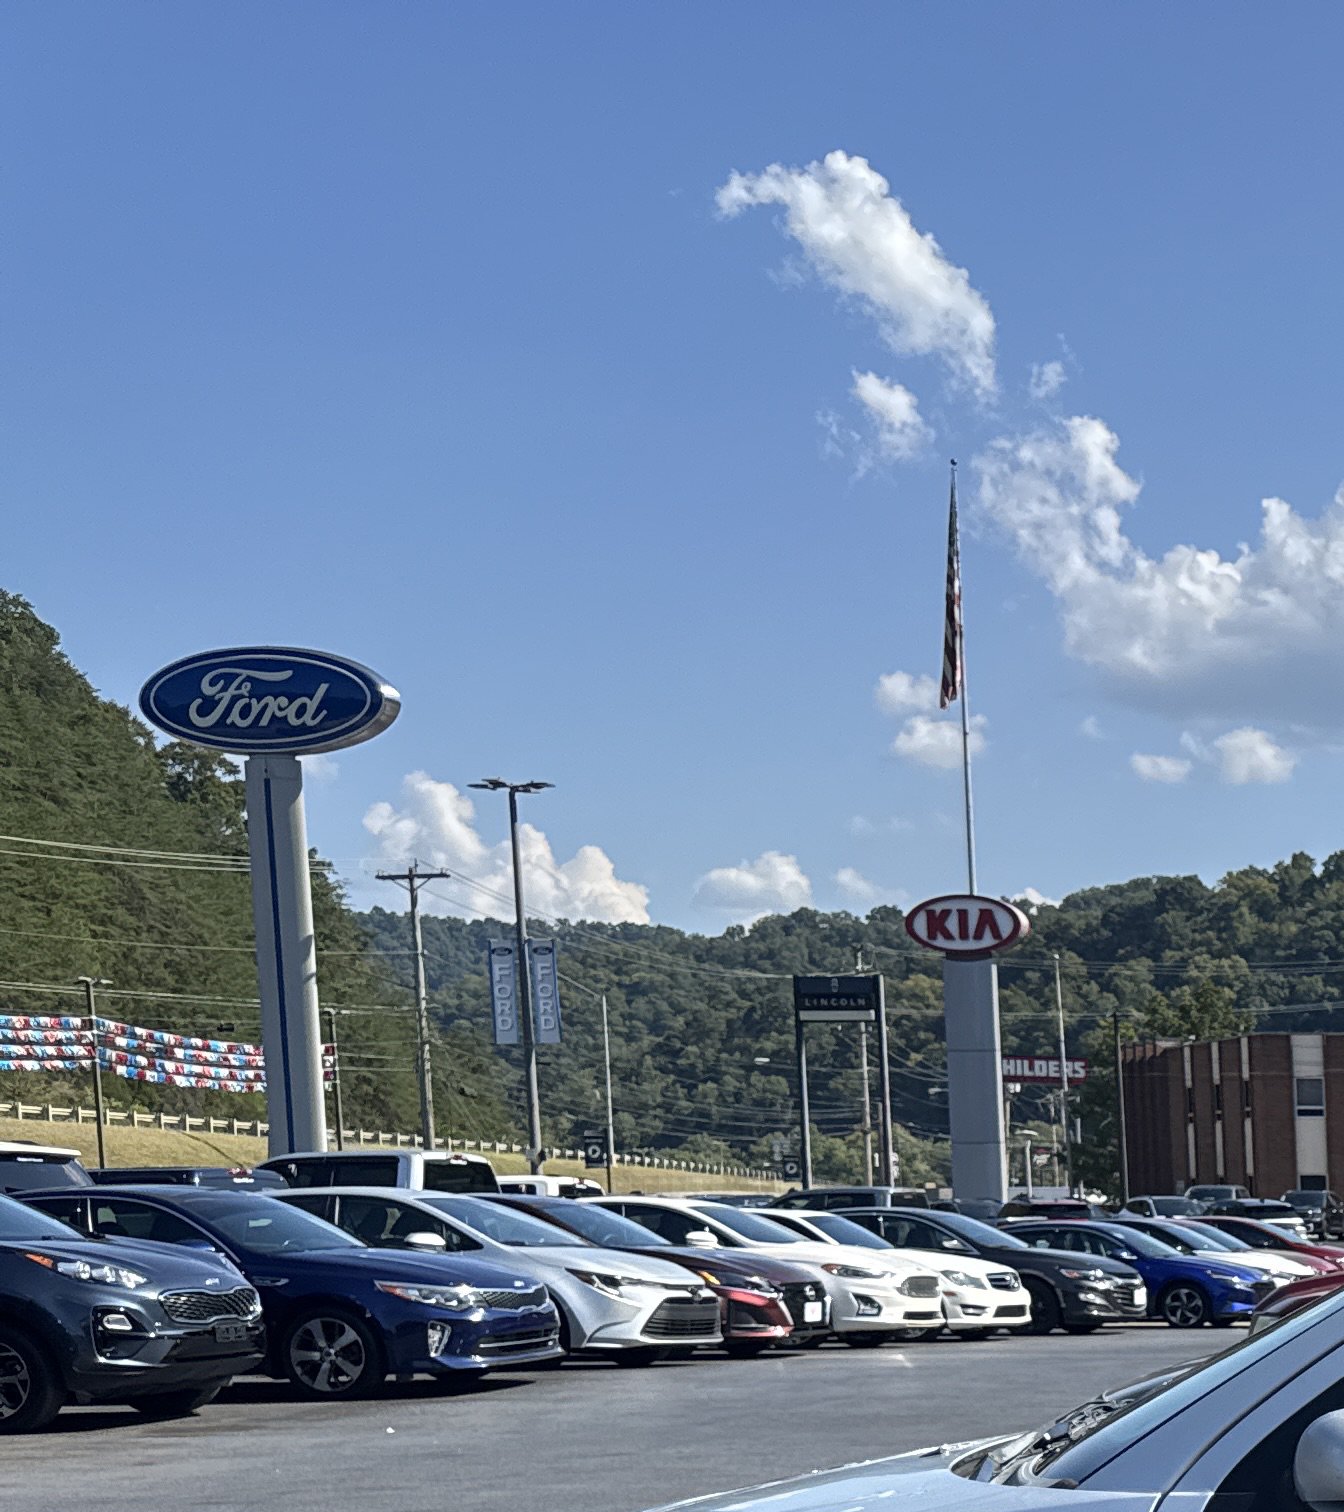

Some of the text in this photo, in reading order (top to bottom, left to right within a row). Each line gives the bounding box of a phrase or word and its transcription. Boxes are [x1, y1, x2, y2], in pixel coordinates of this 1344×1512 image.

[188, 667, 331, 728] Ford
[925, 908, 1003, 941] KIA
[493, 963, 513, 1031] FORD
[537, 963, 556, 1031] FORD
[804, 998, 867, 1006] LINCOLN
